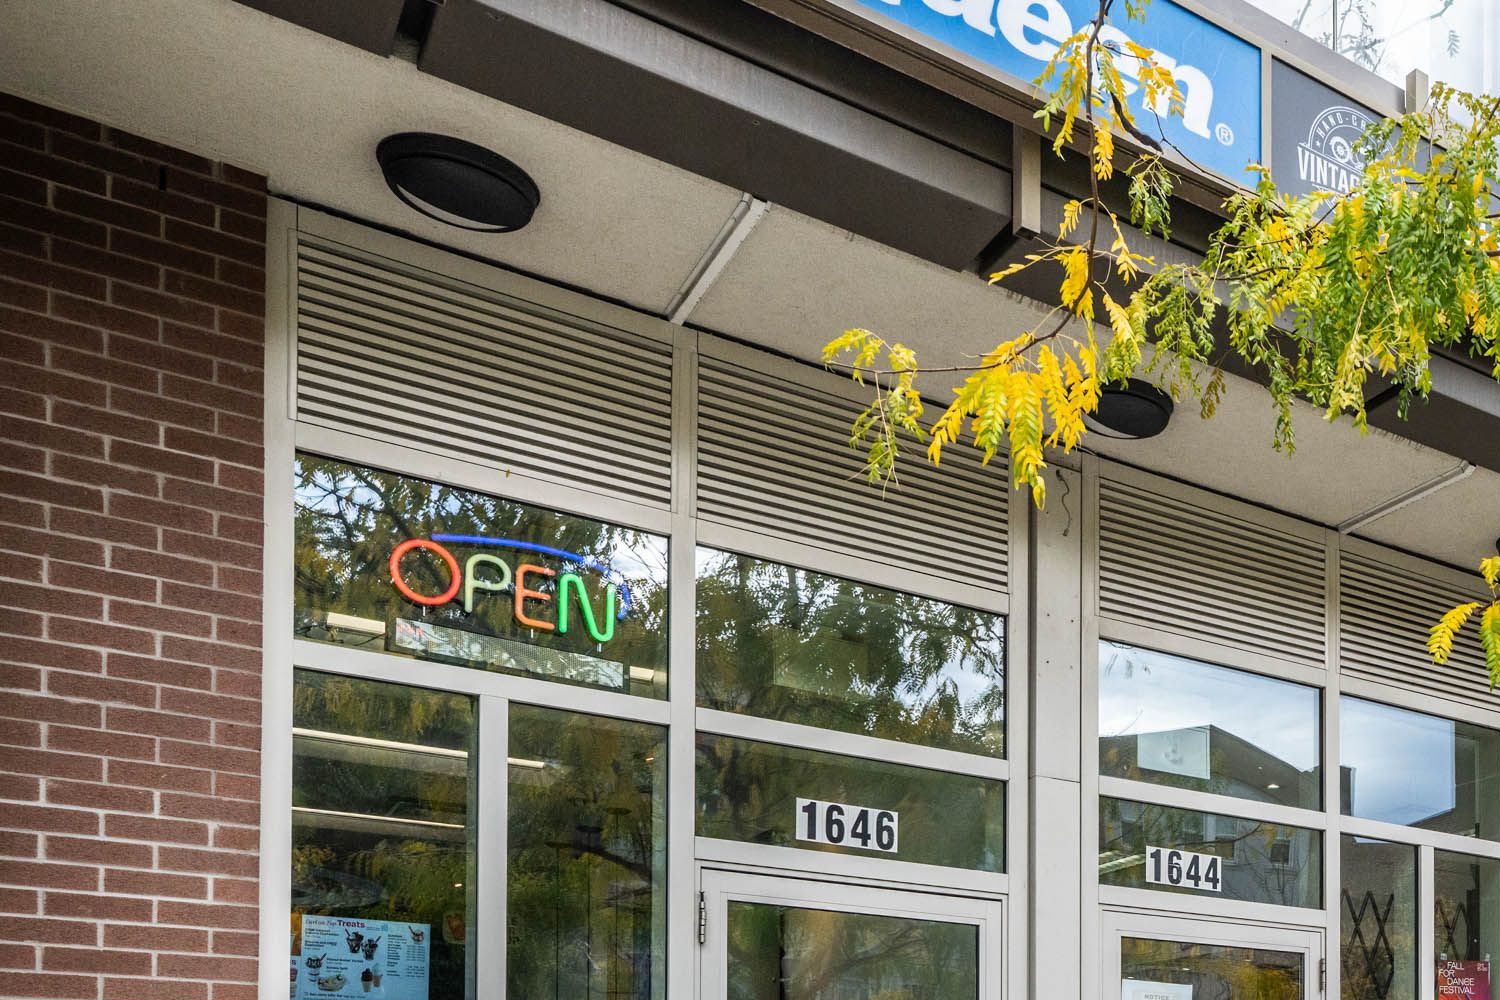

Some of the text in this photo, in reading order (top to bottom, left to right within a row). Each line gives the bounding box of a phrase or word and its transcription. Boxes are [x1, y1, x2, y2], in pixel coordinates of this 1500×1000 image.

[389, 538, 616, 643] OPEN
[802, 801, 895, 850] 1646
[1150, 848, 1220, 890] 1644
[1447, 961, 1465, 970] FALL
[1439, 968, 1455, 978] FOR
[1447, 978, 1475, 987] DANCE
[1440, 985, 1476, 995] FESTIVAL
